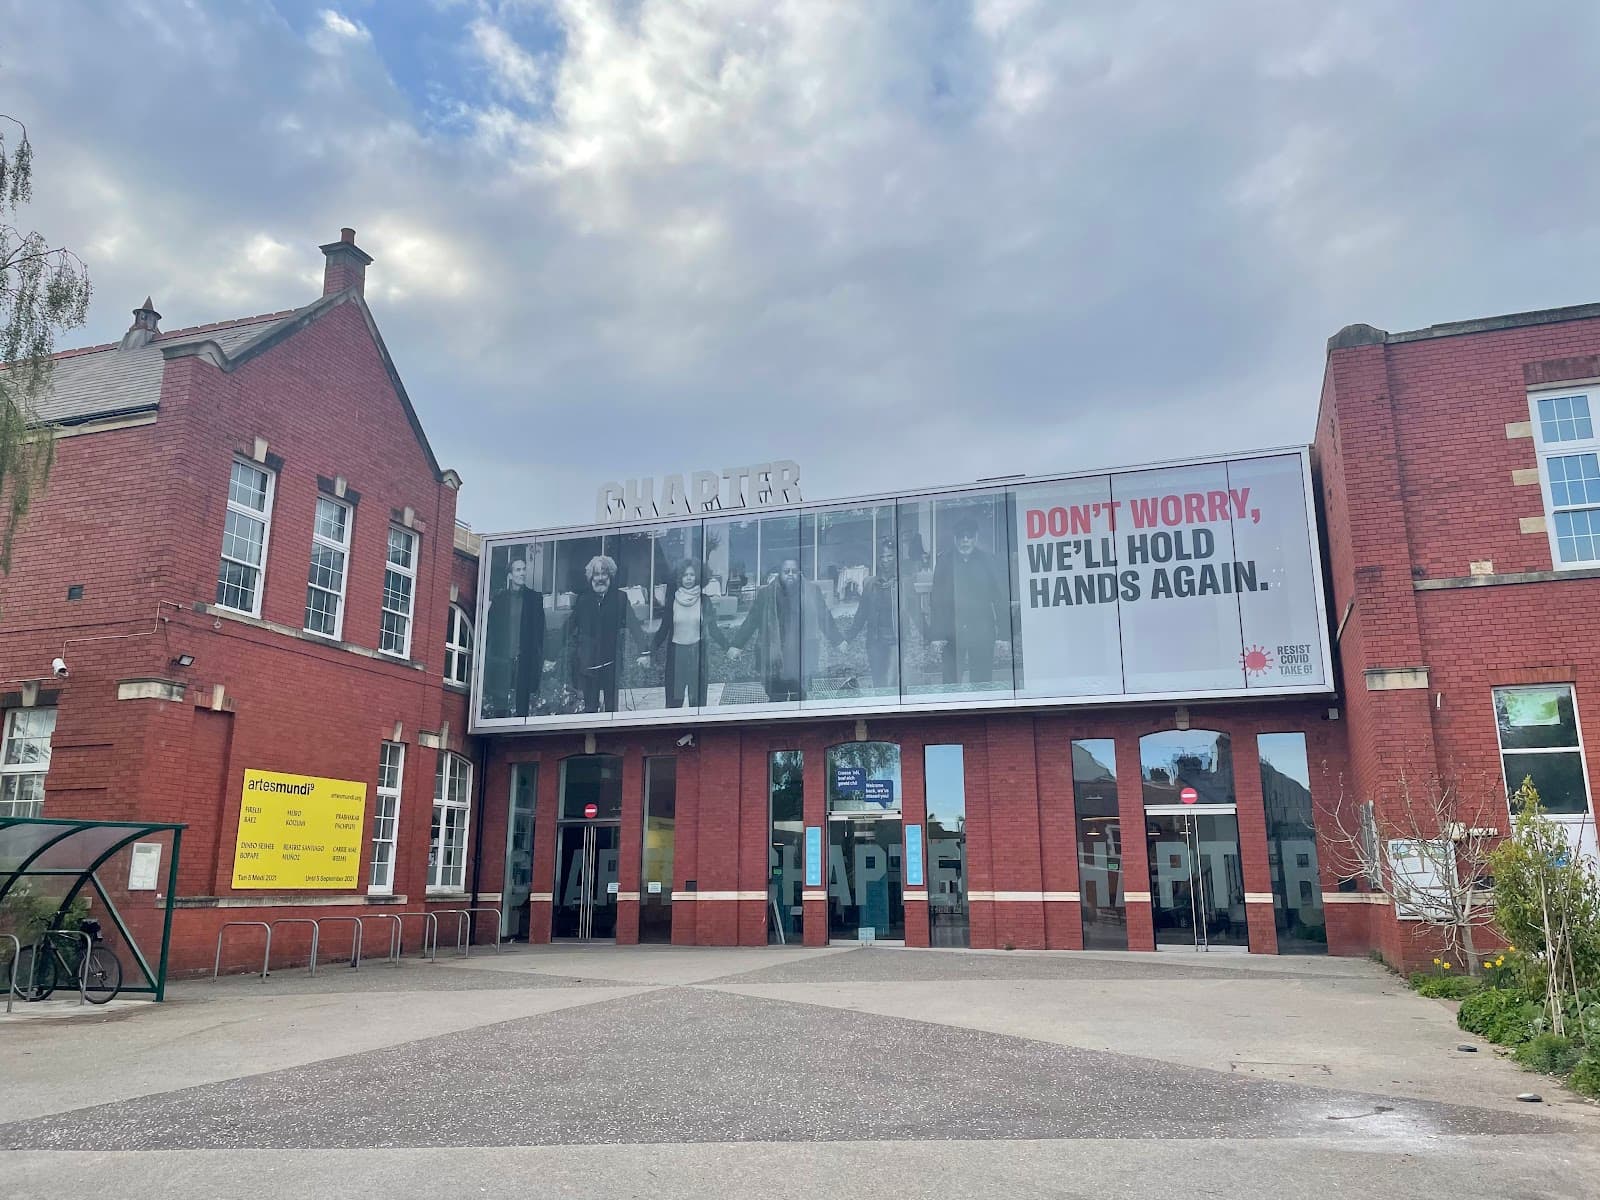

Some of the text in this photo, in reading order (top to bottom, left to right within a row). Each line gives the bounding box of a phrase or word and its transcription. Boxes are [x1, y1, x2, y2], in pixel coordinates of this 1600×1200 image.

[597, 459, 802, 522] CHAPTER
[1026, 487, 1261, 539] DON'T WORRY,
[1026, 528, 1215, 573] WE'LL HOLD
[1030, 560, 1269, 608] HANDS AGAIN.
[1277, 644, 1311, 655] RESIST
[1279, 664, 1313, 675] TAKE 6!
[1281, 654, 1309, 664] COVID
